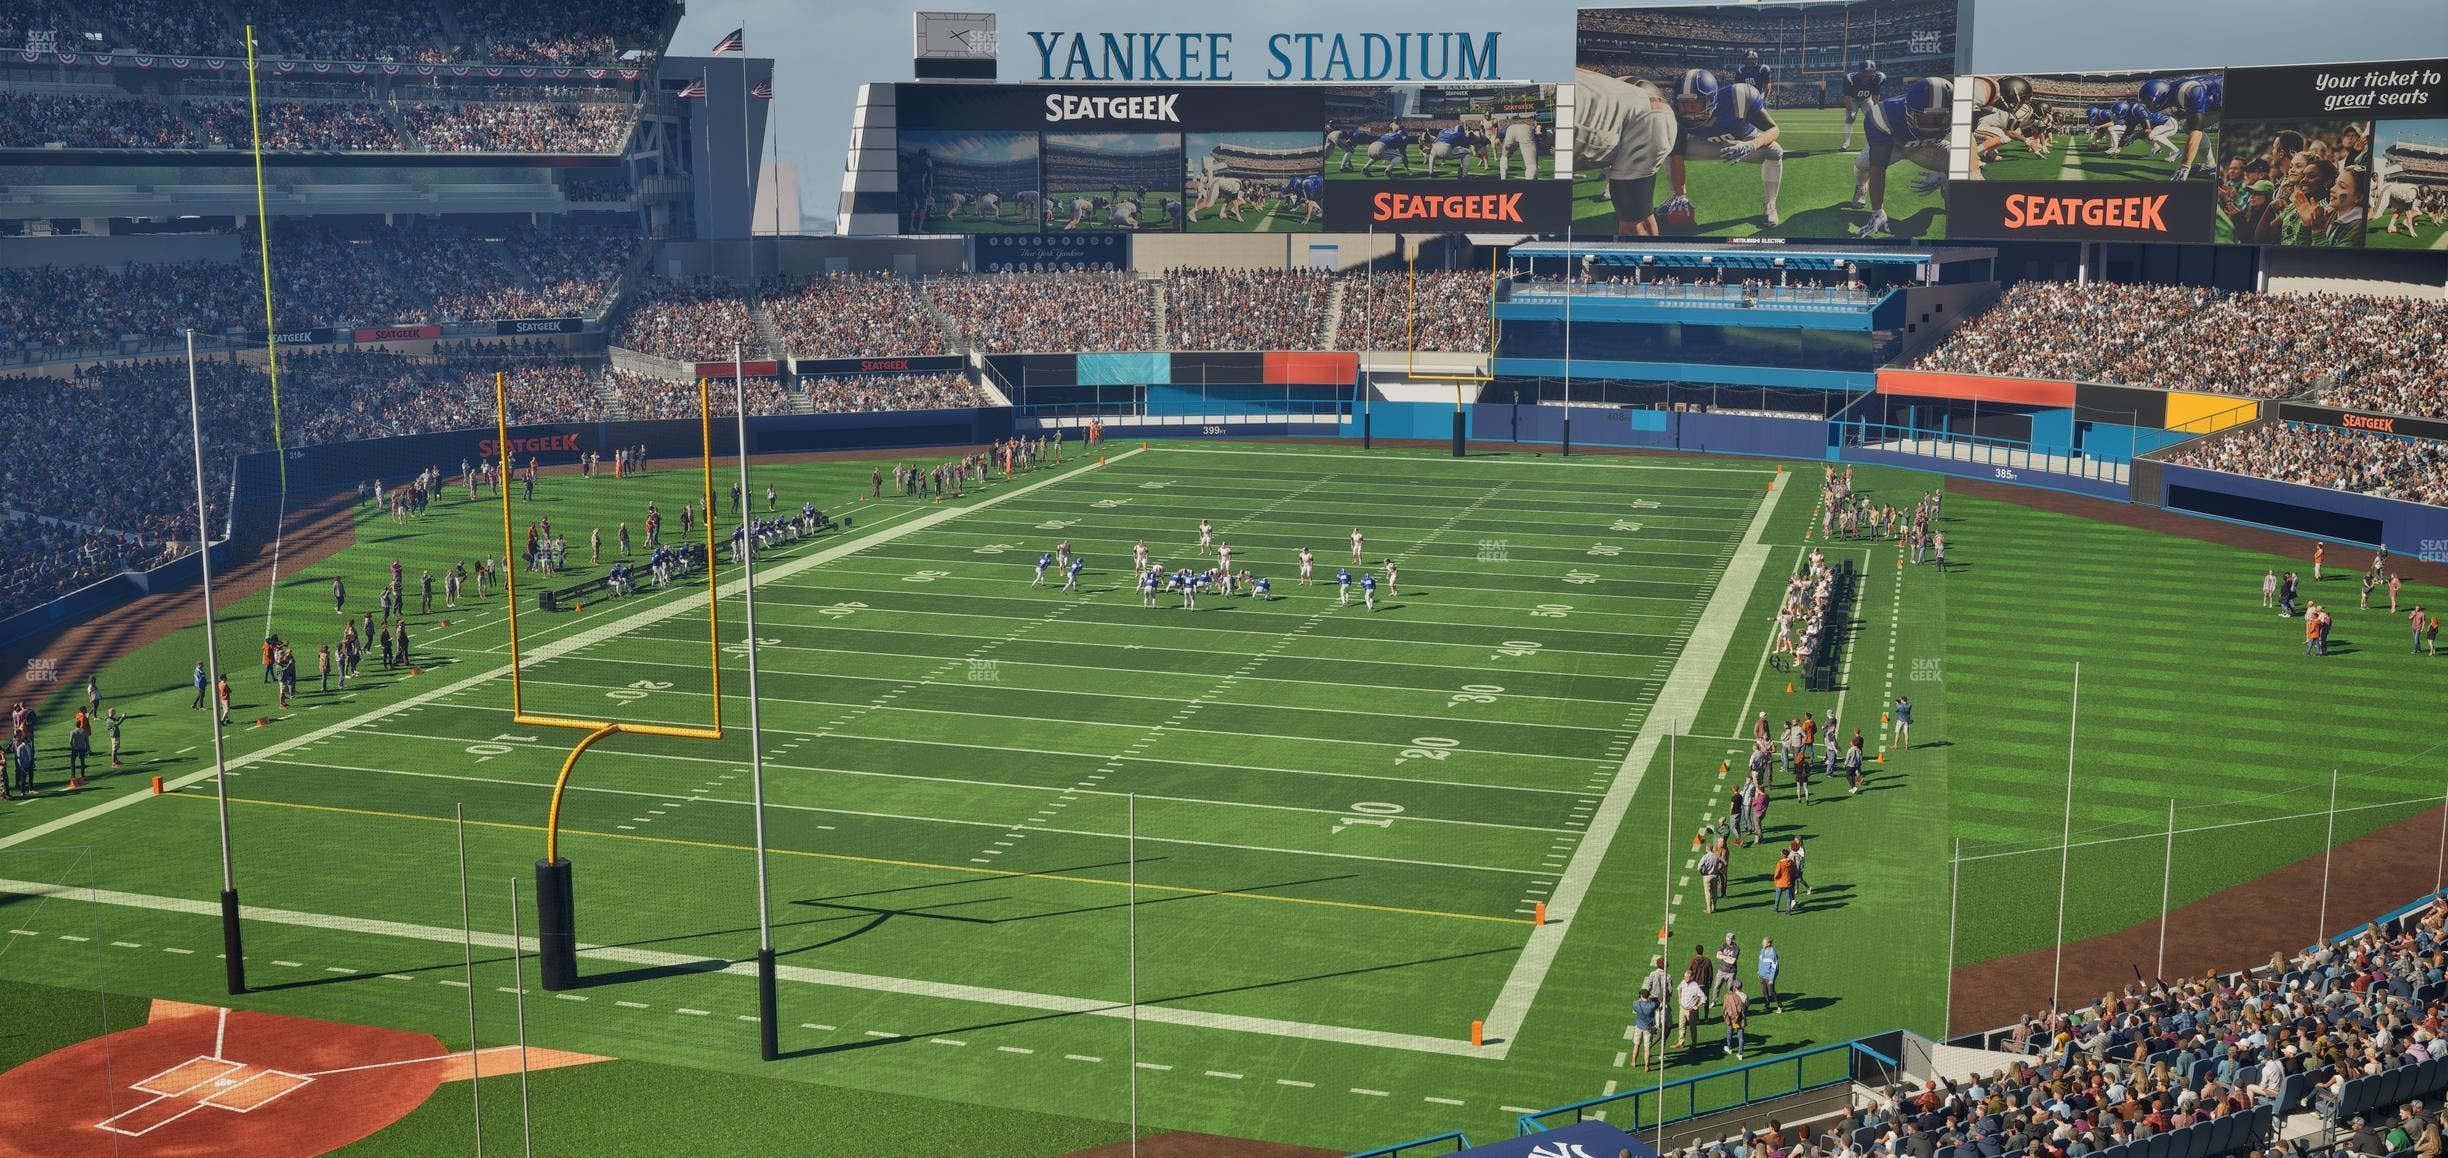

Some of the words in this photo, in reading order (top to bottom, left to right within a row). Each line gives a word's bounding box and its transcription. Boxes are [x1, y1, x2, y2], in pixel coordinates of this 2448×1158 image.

[1027, 31, 1233, 81] YANKEE
[1267, 31, 1502, 81] STADIUM
[2315, 73, 2361, 91] Your
[2364, 70, 2420, 87] ticket
[2422, 69, 2441, 85] to
[1045, 93, 1180, 123] SEATGEEK
[2324, 90, 2376, 111] great
[2378, 88, 2429, 105] seats
[1373, 192, 1524, 223] SEATGEEK
[2004, 194, 2168, 232] SEATGEEK
[375, 329, 420, 339] SEATGEEK
[517, 321, 560, 332] SEATGEEK
[862, 360, 908, 370] SEATGEEK
[2343, 413, 2393, 432] SEATGEEK
[1400, 737, 1460, 760] 20
[1340, 801, 1405, 829] 10
